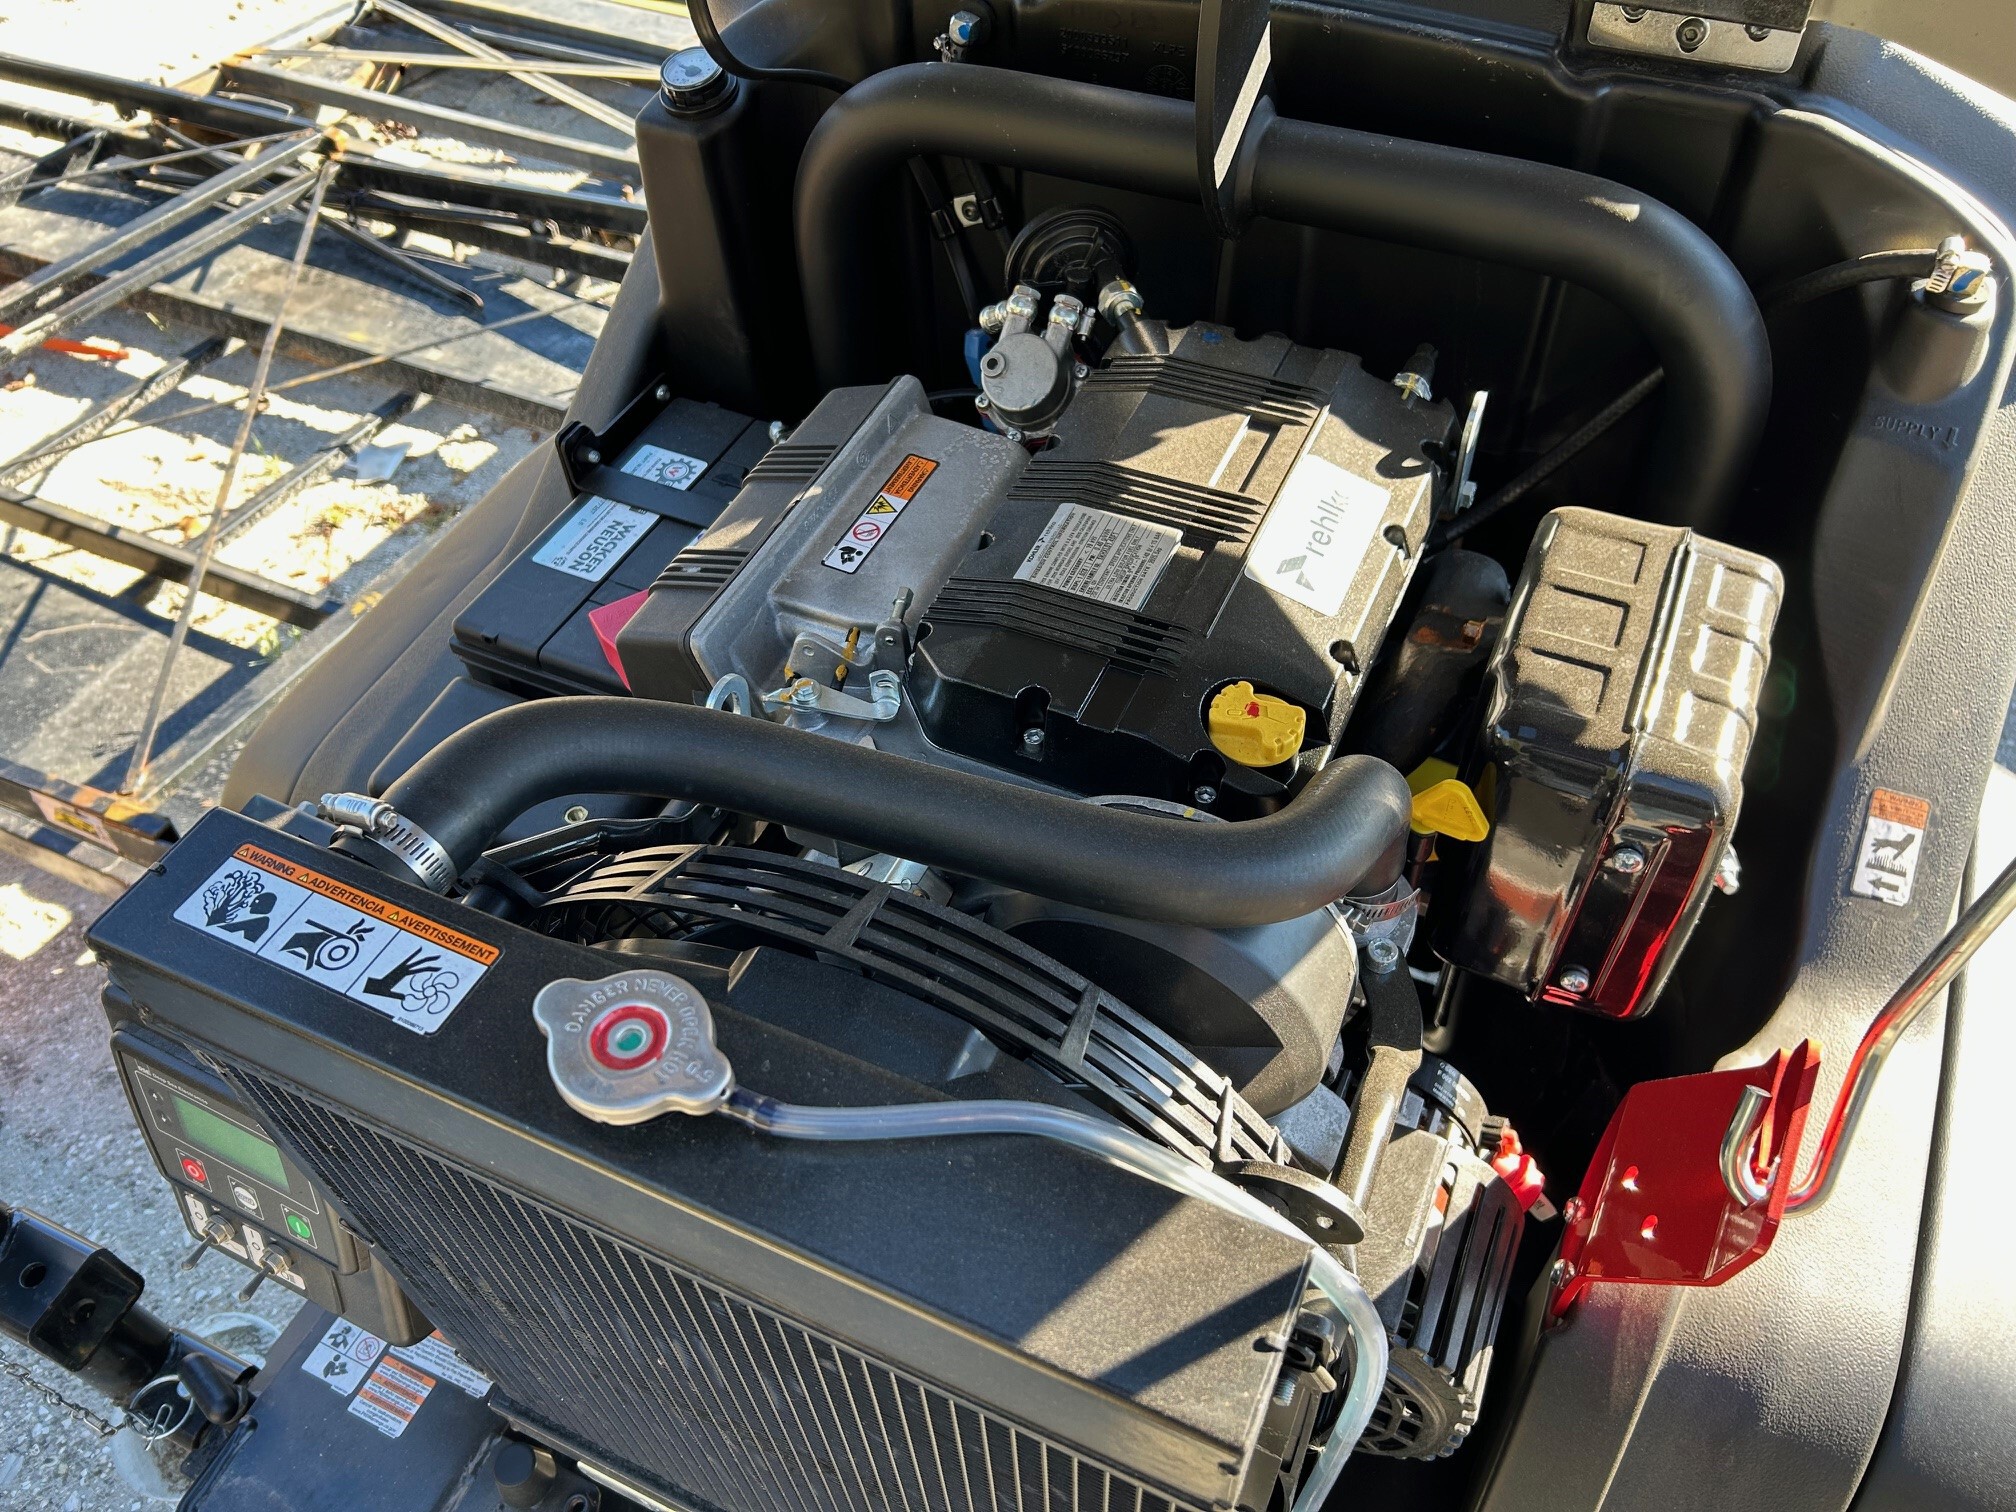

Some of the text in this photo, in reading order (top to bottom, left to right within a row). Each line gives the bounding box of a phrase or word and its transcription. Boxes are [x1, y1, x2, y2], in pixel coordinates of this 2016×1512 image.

[1873, 415, 1942, 440] SUPPLY
[568, 519, 619, 572] NEUSON
[579, 523, 636, 574] WACKER
[1306, 489, 1349, 557] rehlk
[250, 850, 495, 960] WARNING ADVERTENCIA AVERTISSEMENT
[564, 979, 629, 1034] DANGER
[634, 978, 689, 1005] NEVER
